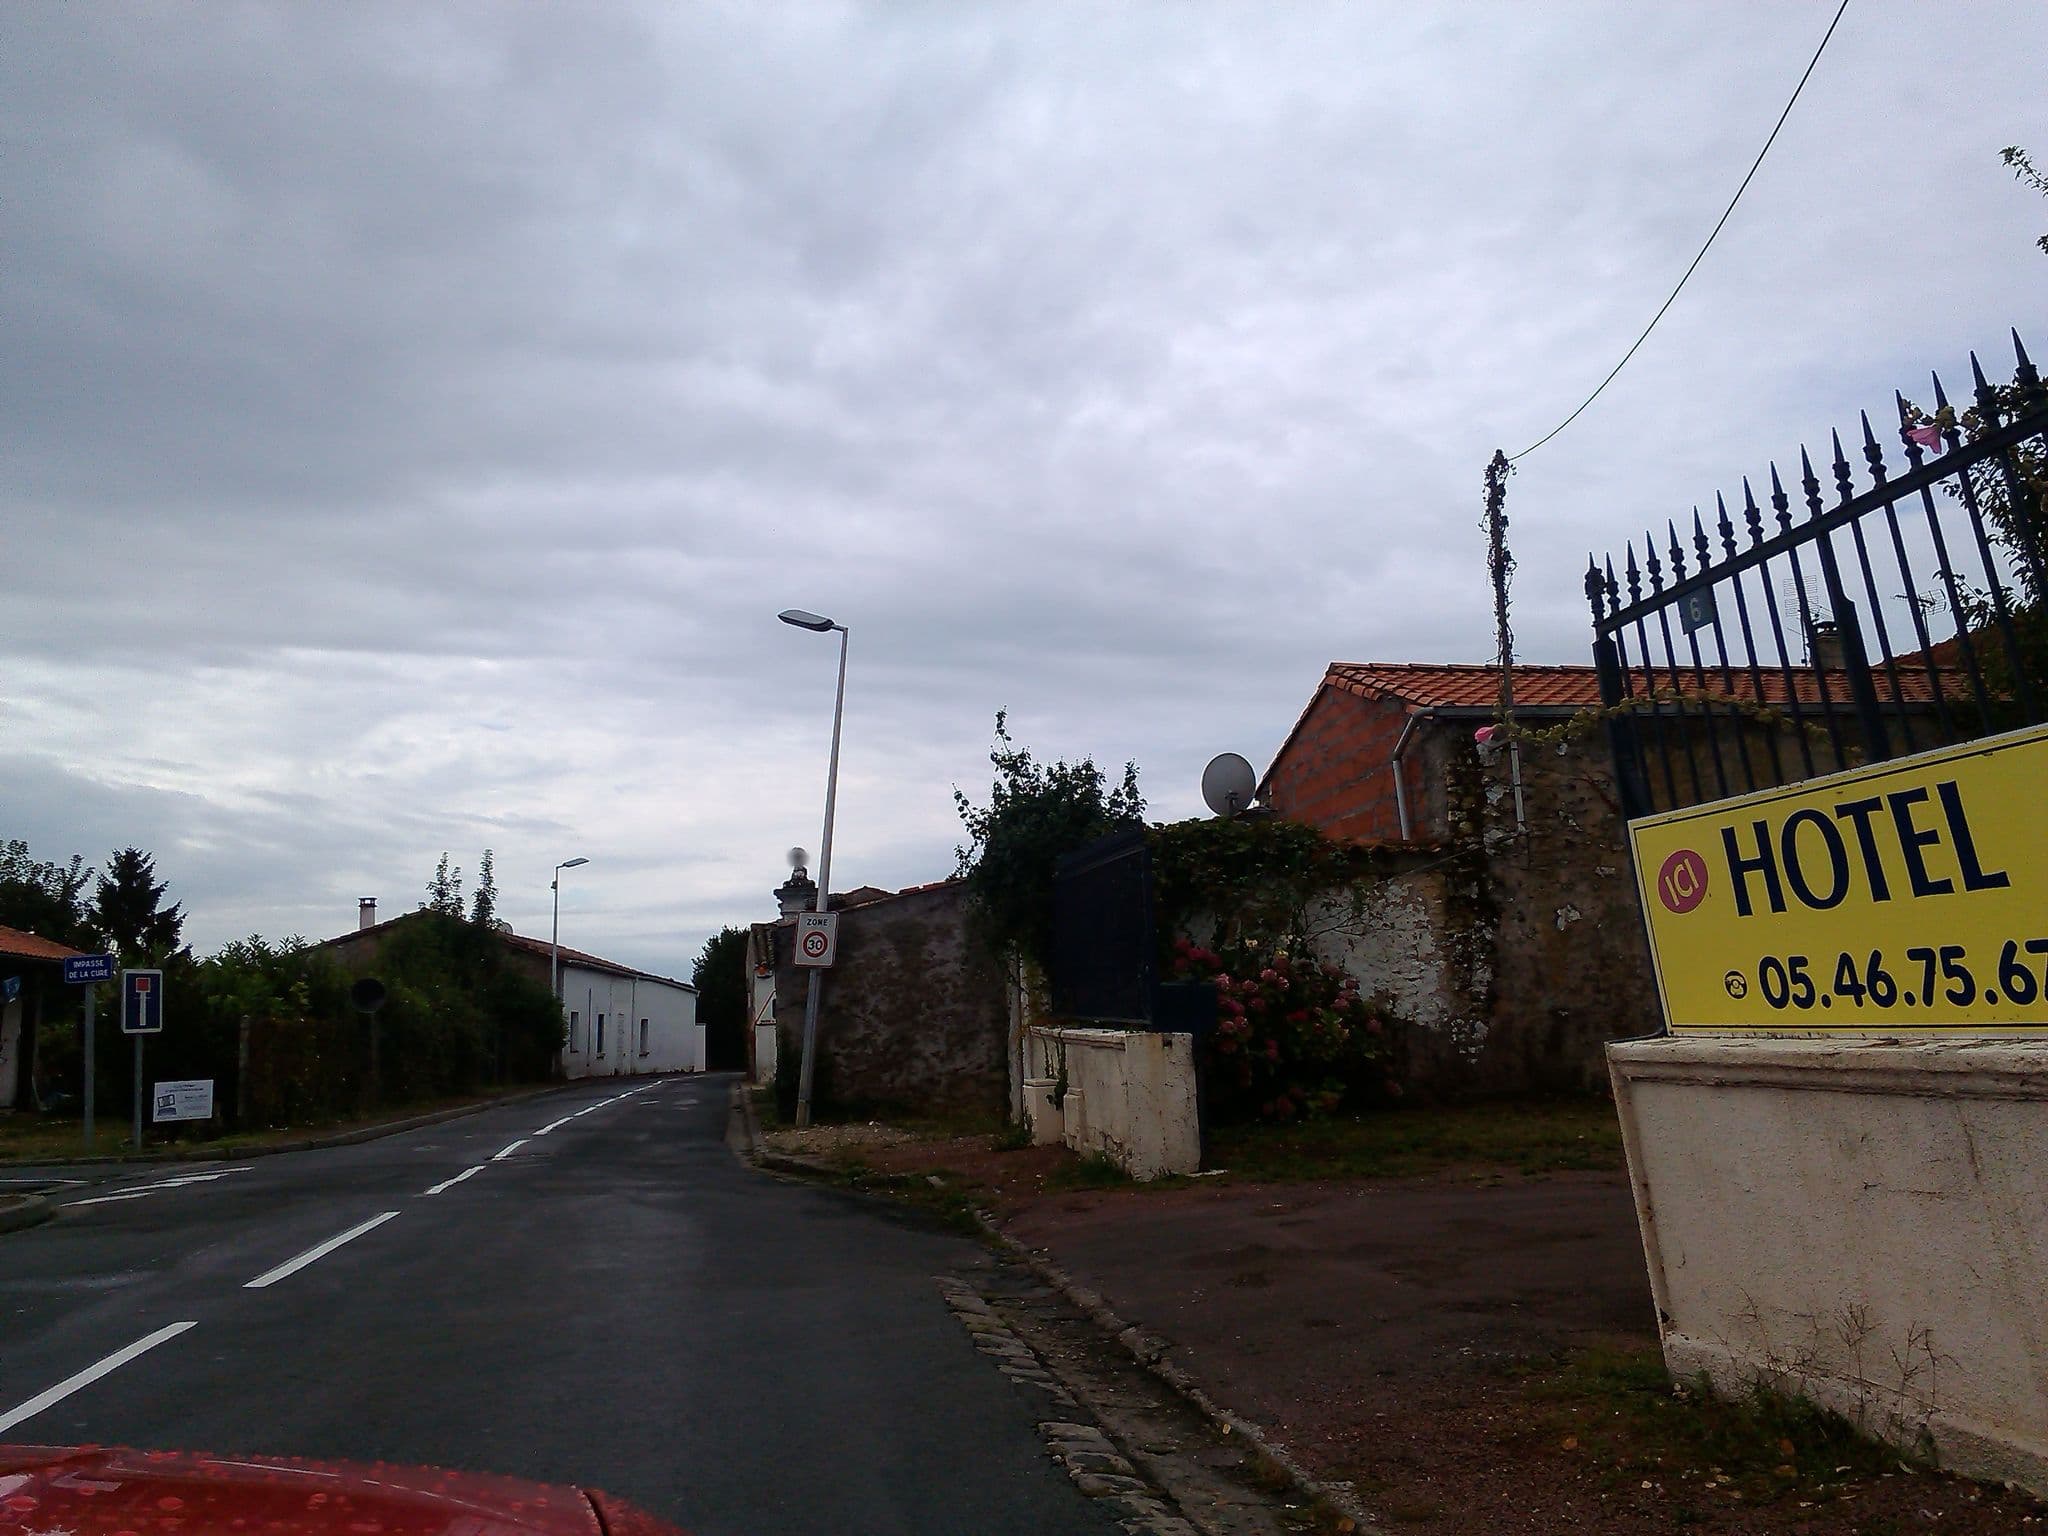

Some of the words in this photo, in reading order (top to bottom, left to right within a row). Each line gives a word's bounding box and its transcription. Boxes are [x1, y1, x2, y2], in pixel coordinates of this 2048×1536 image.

[1689, 597, 1701, 622] 6
[1720, 780, 2011, 917] HOTEL
[1664, 858, 1699, 907] ICI
[806, 918, 829, 927] ZONE
[808, 939, 823, 950] 30
[73, 960, 104, 968] IMPASSE
[80, 970, 89, 978] LA
[90, 969, 109, 977] CURE
